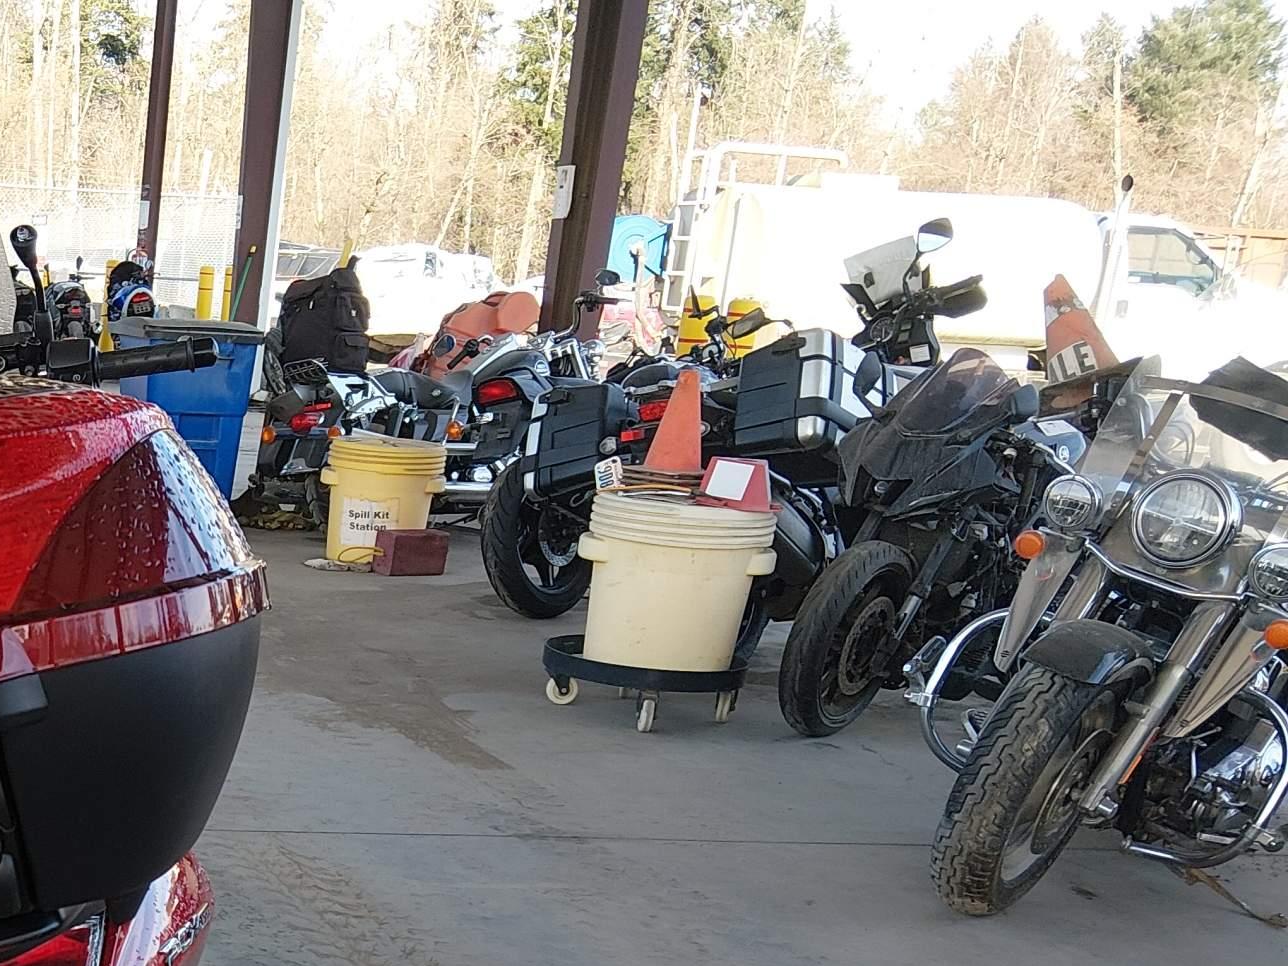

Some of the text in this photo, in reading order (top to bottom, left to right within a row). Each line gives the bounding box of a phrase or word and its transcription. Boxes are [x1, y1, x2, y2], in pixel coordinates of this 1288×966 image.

[348, 509, 390, 520] Spill Kit
[349, 522, 386, 531] Station
